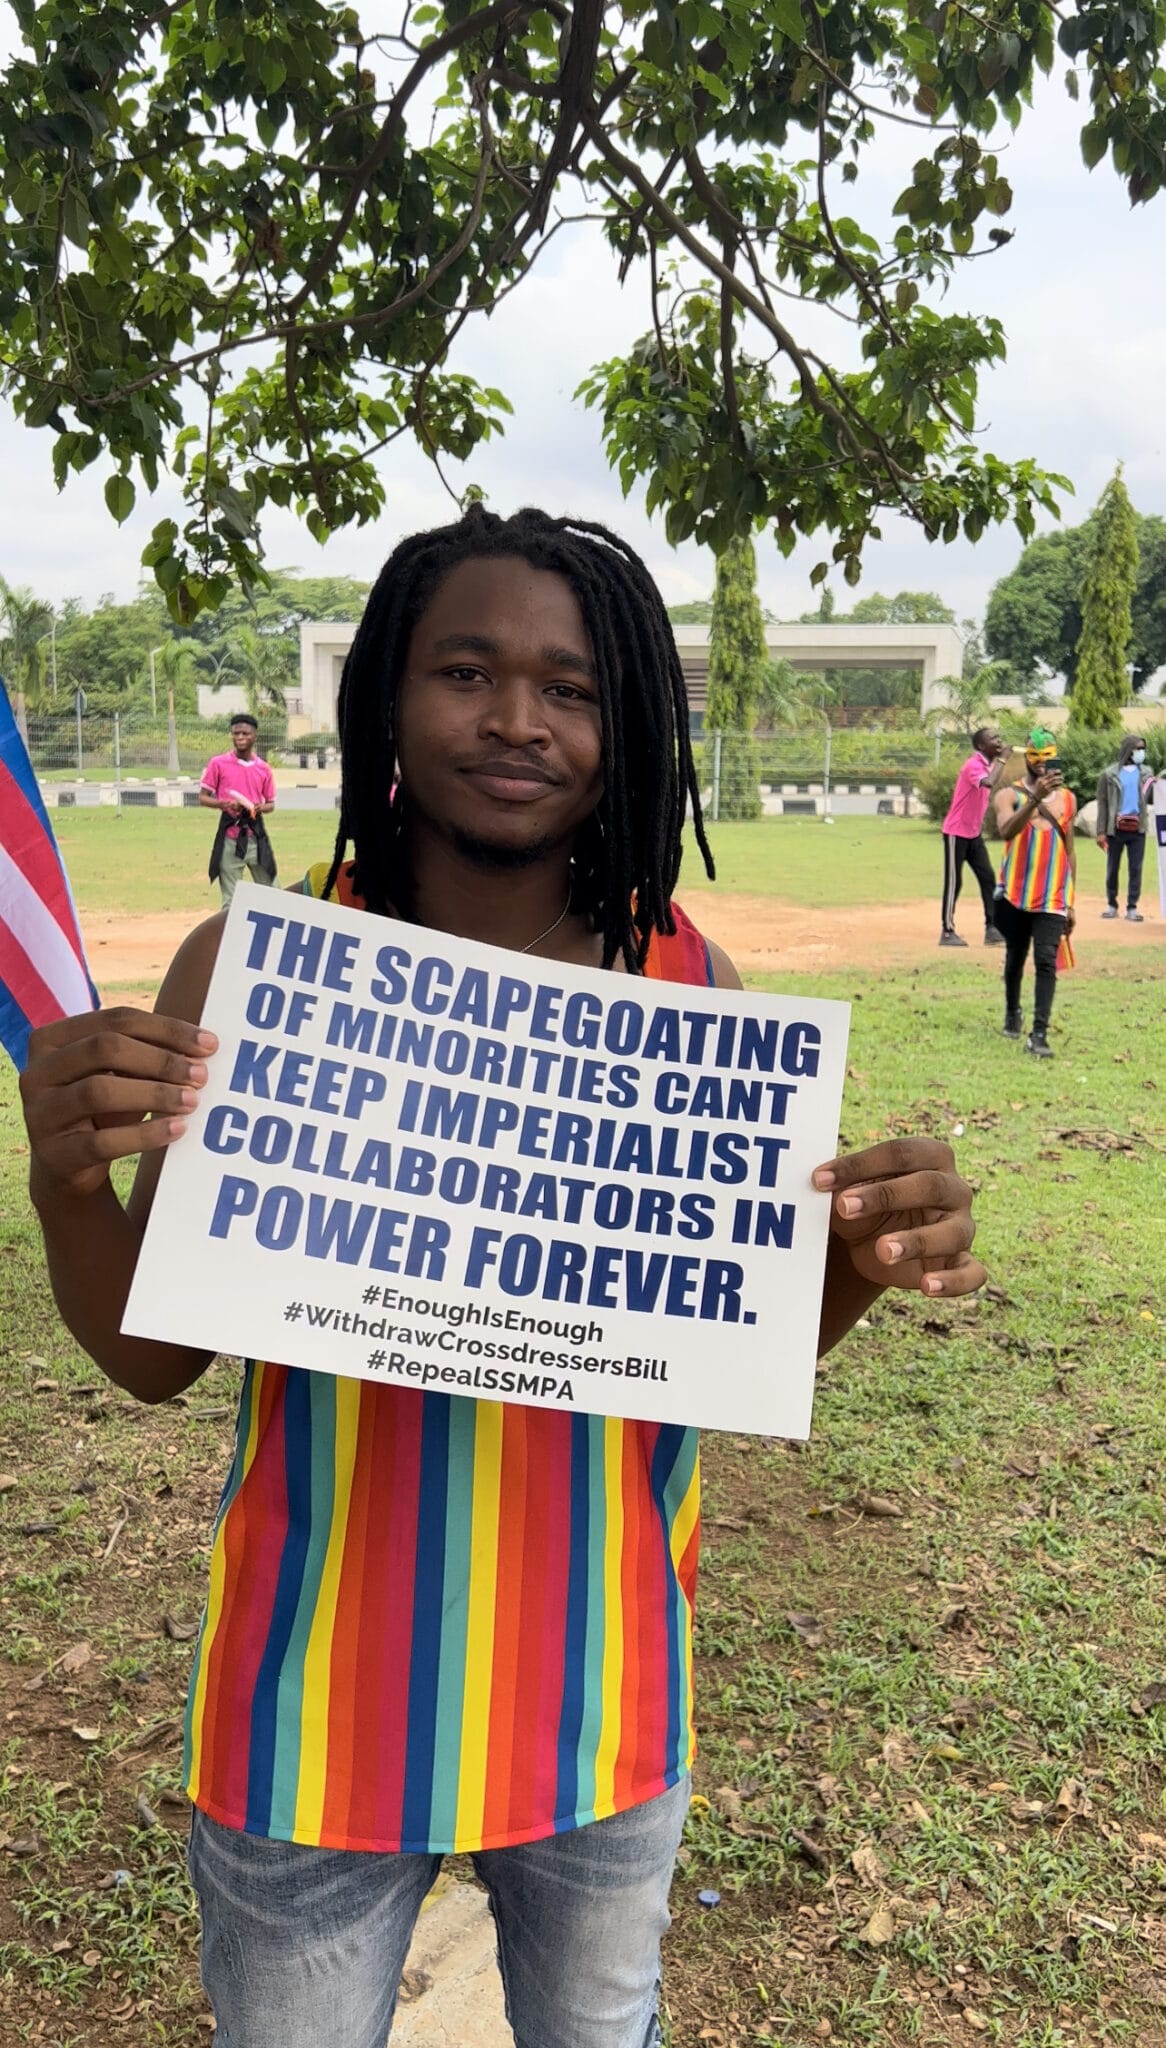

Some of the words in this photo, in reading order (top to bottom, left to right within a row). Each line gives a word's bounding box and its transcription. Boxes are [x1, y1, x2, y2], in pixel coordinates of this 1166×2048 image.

[246, 910, 360, 993] THE
[371, 946, 821, 1077] SCAPEGOATING
[246, 983, 318, 1036] OF
[326, 1002, 640, 1108] MINORITIES
[654, 1072, 797, 1125] CANT
[203, 1106, 715, 1240] COLLABORATORS
[732, 1199, 795, 1249] IN
[229, 1039, 386, 1119] KEEP
[398, 1080, 790, 1188] IMPERIALIST
[209, 1175, 450, 1281] POWER
[464, 1227, 757, 1324] FOREVER.
[361, 1286, 604, 1345] #EnoughIsEnough
[283, 1302, 668, 1382] #WithdrawCrossdressersBill
[366, 1350, 575, 1401] #RepealSSMPA
